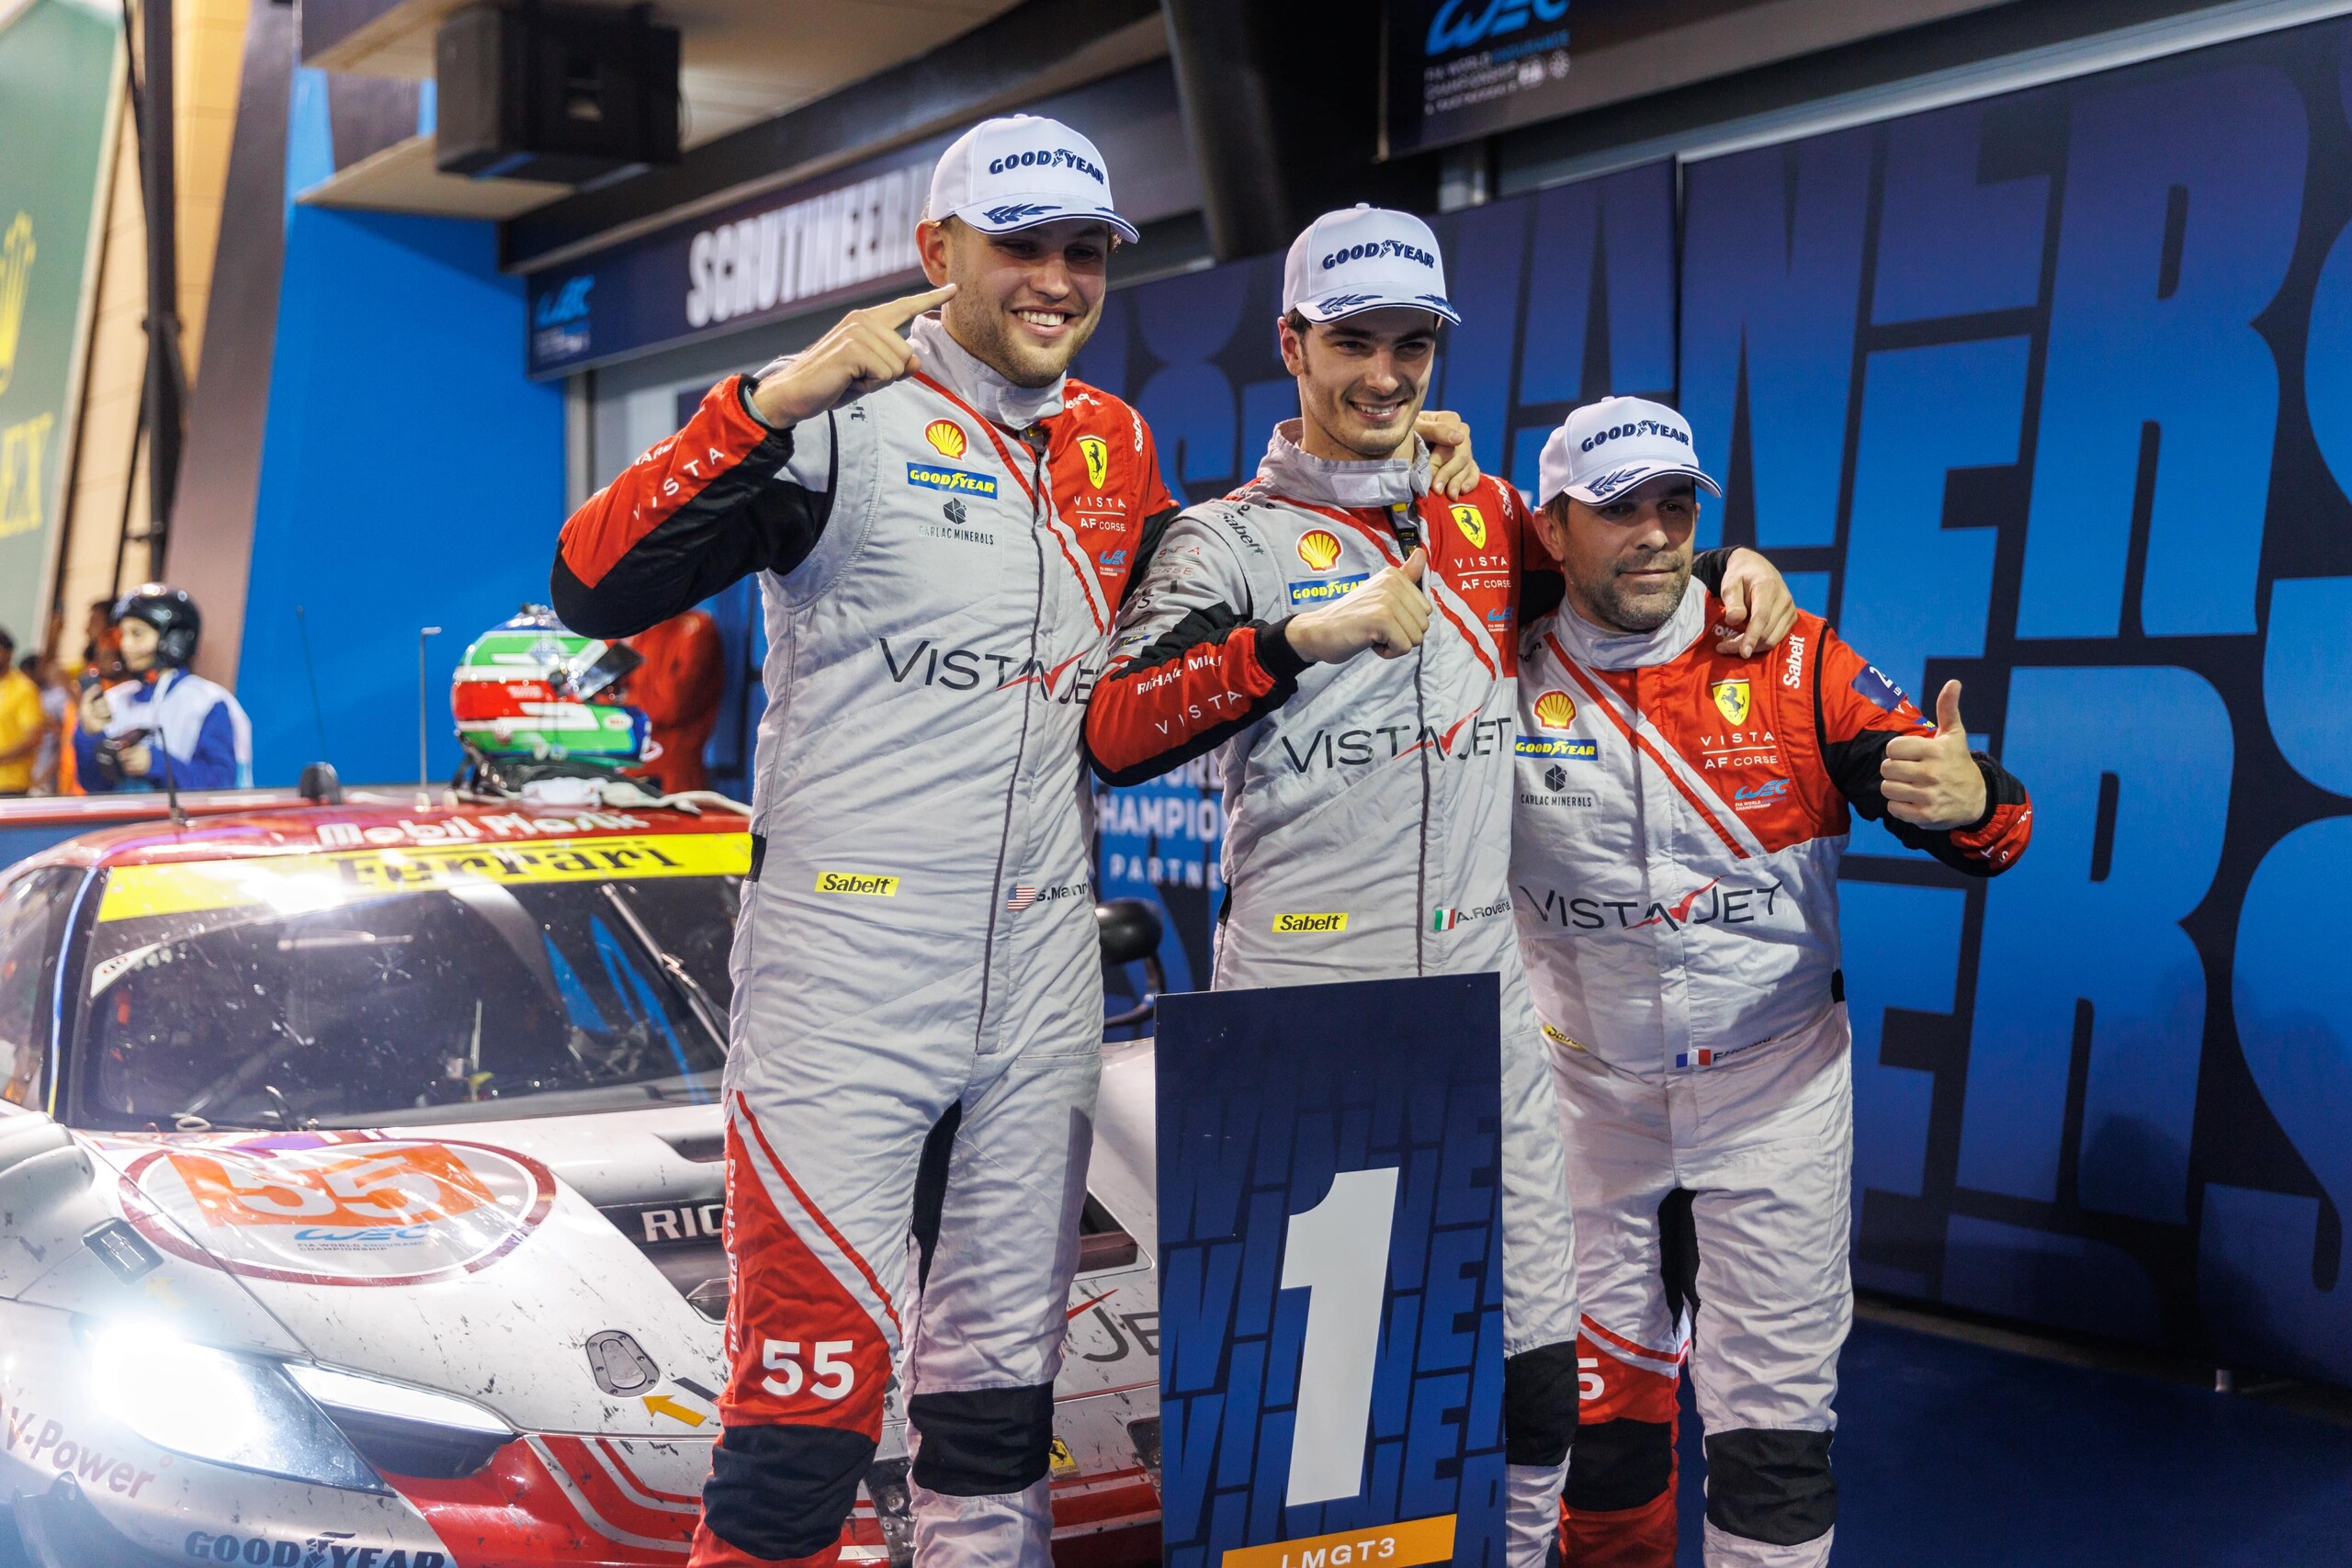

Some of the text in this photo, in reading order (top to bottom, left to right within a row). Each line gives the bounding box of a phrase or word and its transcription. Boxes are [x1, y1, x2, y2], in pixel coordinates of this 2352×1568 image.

[989, 148, 1104, 186] GOODYEAR
[1322, 239, 1434, 271] GOODYEAR
[1580, 420, 1690, 453] GOODYEAR
[633, 446, 725, 521] VISTA
[910, 469, 995, 494] GOODYEAR
[1074, 496, 1126, 509] VISTA
[919, 525, 994, 545] CARLAC MINERALS
[1080, 517, 1126, 533] AF CORSE
[1453, 556, 1508, 570] VISTA
[1292, 580, 1365, 600] GOODYEA
[1461, 578, 1512, 591] AF CORSE
[878, 637, 1100, 705] VISTAJE
[1783, 634, 1805, 690] Sabelt
[1156, 690, 1243, 736] VISTA
[1281, 716, 1512, 773] VISTAJET
[1515, 739, 1596, 756] GOODYEAR
[1700, 731, 1776, 747] VISTA
[1704, 755, 1778, 770] AF CORSE
[1521, 794, 1592, 807] CARLAC MINERALS
[1093, 794, 1227, 842] HAMPIO
[823, 874, 891, 895] Sabelt
[1456, 900, 1511, 924] A.Rovera
[1519, 880, 1783, 931] VISTAJET
[1279, 913, 1342, 932] Sabelt
[1280, 1167, 1400, 1507] 1
[762, 1338, 854, 1400] 55
[6, 1405, 156, 1499] V-Power
[185, 1530, 446, 1568] GOODYEAR
[1282, 1537, 1396, 1568] LMGT3
